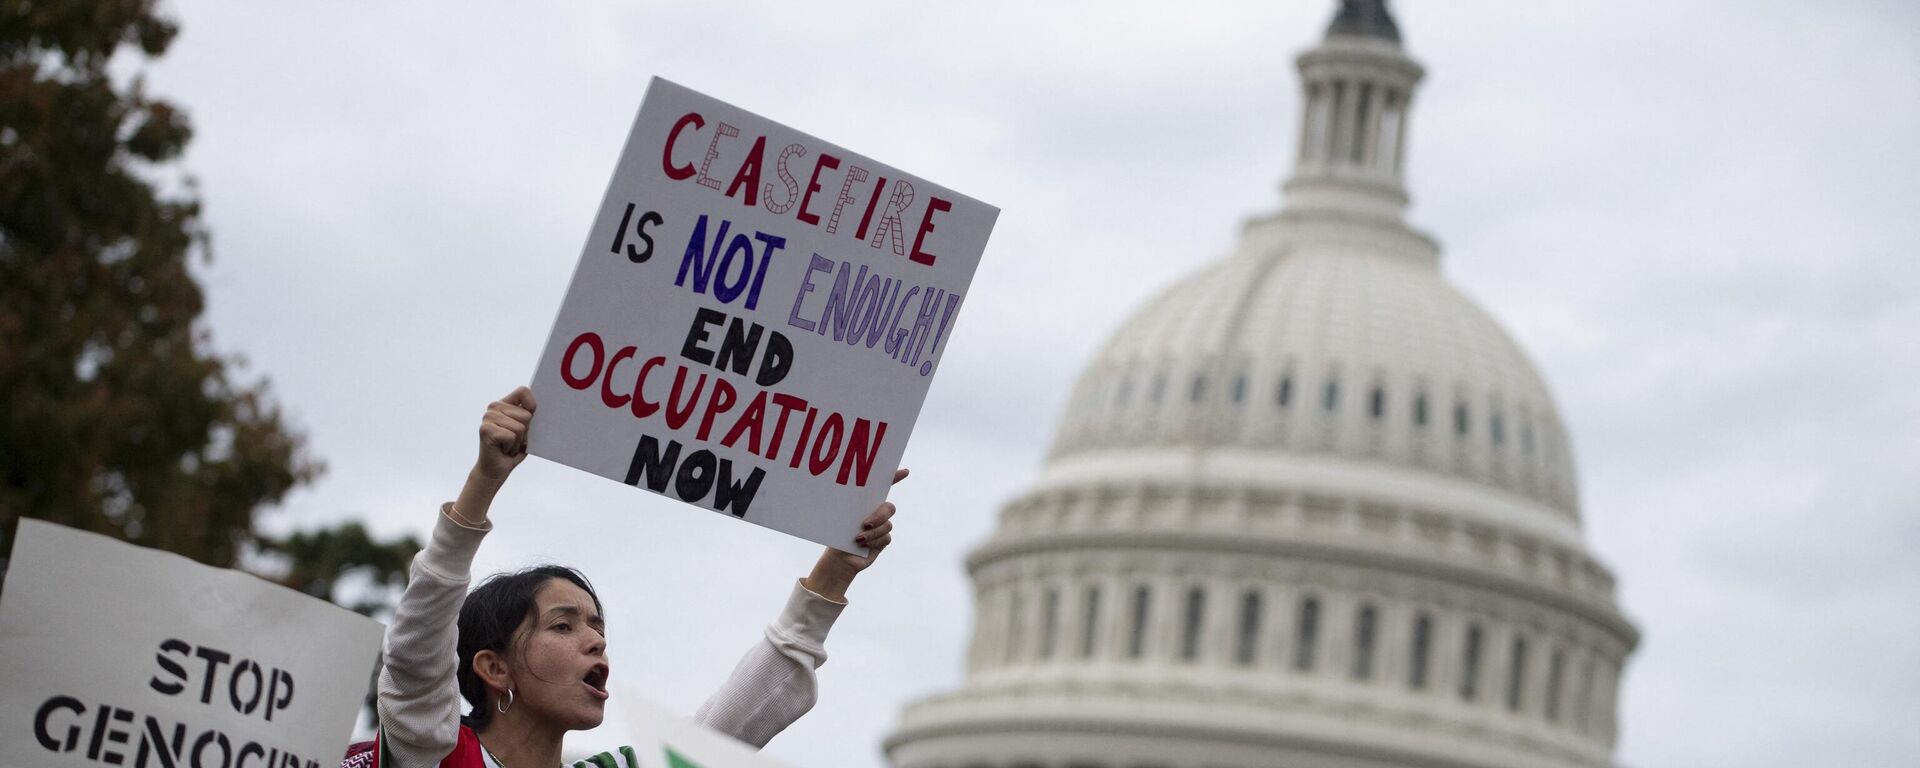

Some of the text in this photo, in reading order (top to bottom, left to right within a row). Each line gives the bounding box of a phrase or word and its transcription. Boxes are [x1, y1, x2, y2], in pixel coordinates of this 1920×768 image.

[662, 113, 952, 266] CEASEFIRE
[610, 203, 961, 377] IS NOT ENOUGH!
[680, 307, 794, 387] END
[560, 332, 888, 488] OCCUPATION
[624, 434, 767, 519] NOW
[149, 638, 294, 721] STOP
[34, 695, 321, 768] GENO
